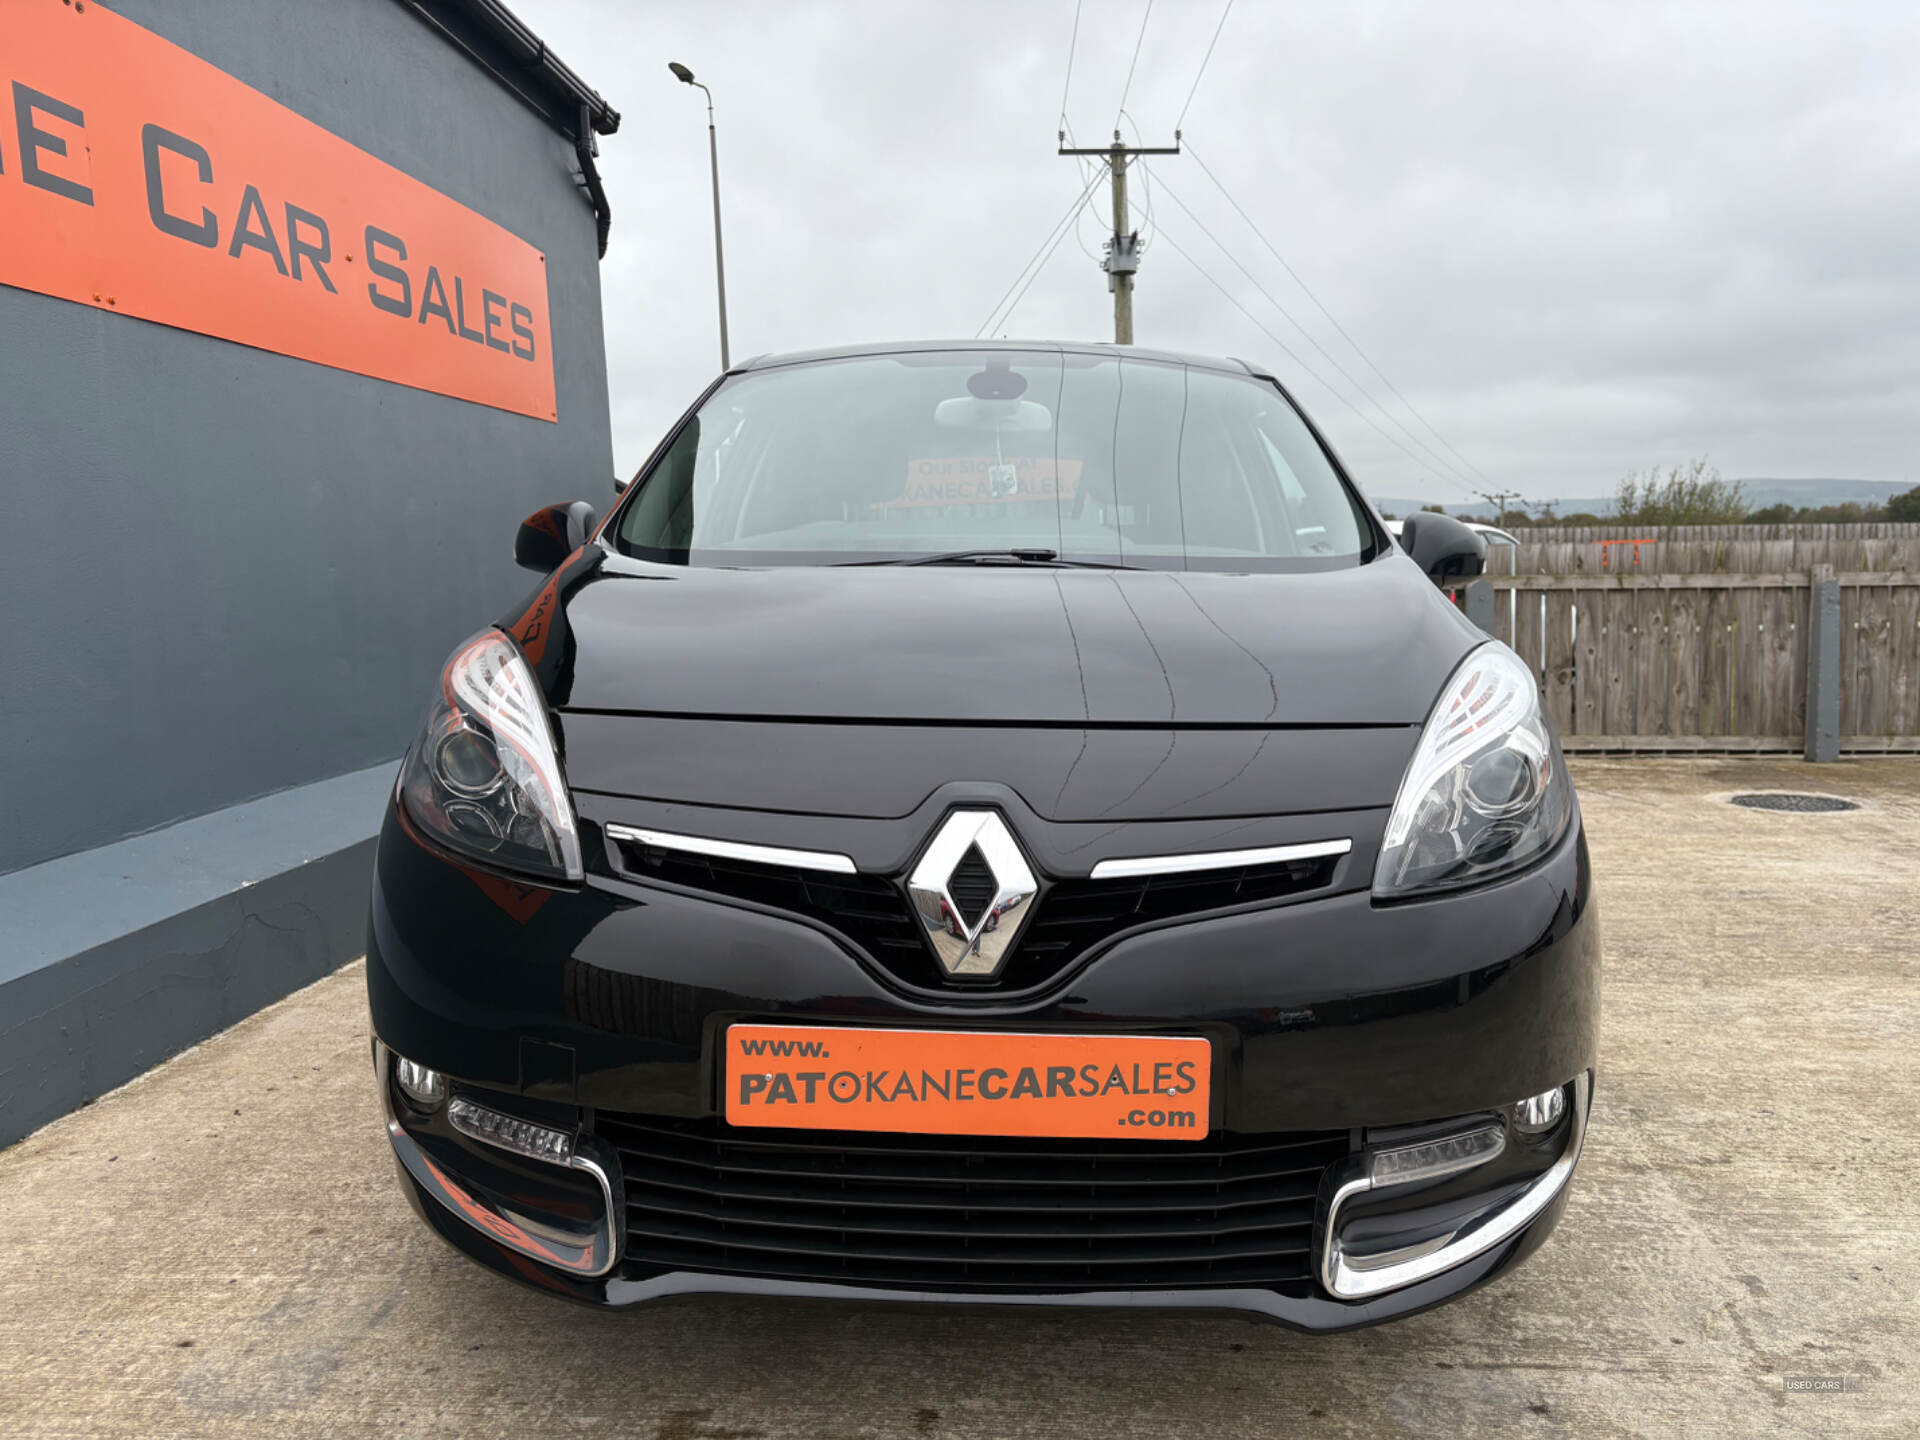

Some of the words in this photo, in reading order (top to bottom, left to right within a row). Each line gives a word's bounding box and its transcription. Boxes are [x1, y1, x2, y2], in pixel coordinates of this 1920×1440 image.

[0, 80, 94, 206] E
[141, 122, 338, 294] CAR
[364, 224, 535, 361] SALES
[740, 1039, 830, 1058] www.
[740, 1061, 1196, 1105] PATOKANECARSALES
[1118, 1108, 1196, 1128] .com
